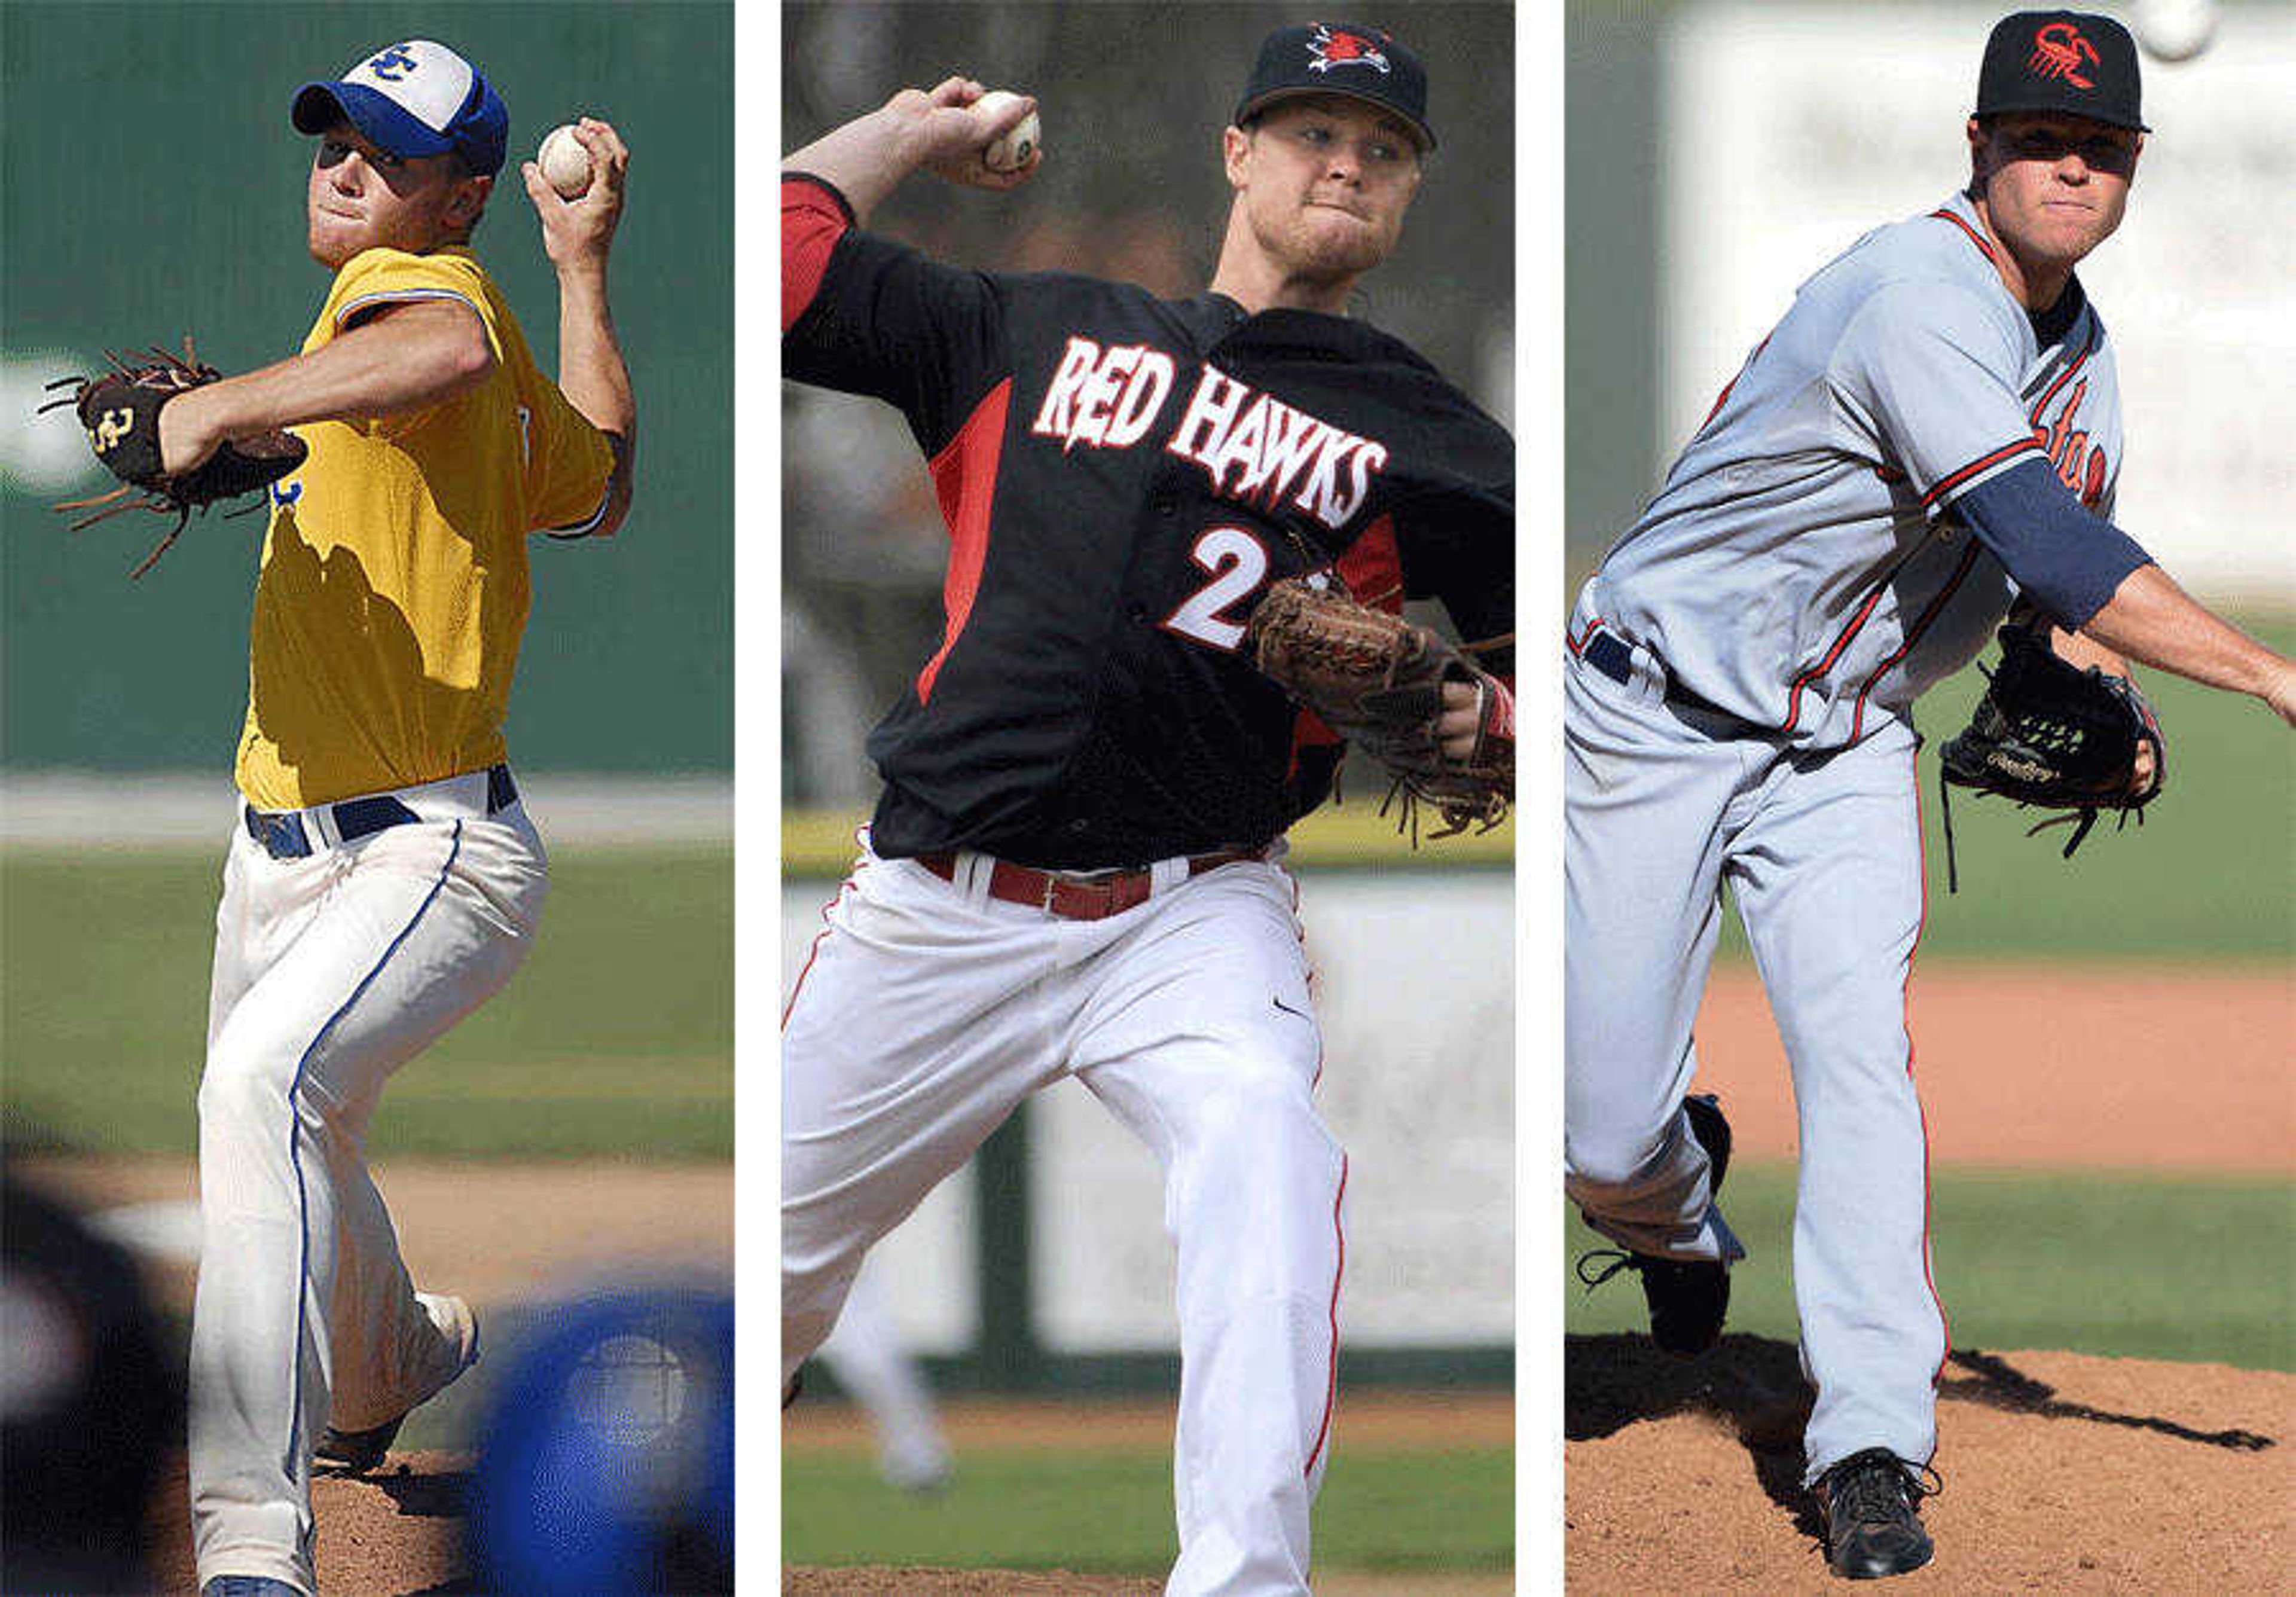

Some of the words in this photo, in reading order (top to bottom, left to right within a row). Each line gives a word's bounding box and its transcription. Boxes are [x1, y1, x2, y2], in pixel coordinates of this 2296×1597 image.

[1031, 335, 1176, 457] RED
[1165, 361, 1388, 530] HAWKS
[1162, 521, 1334, 652] 2
